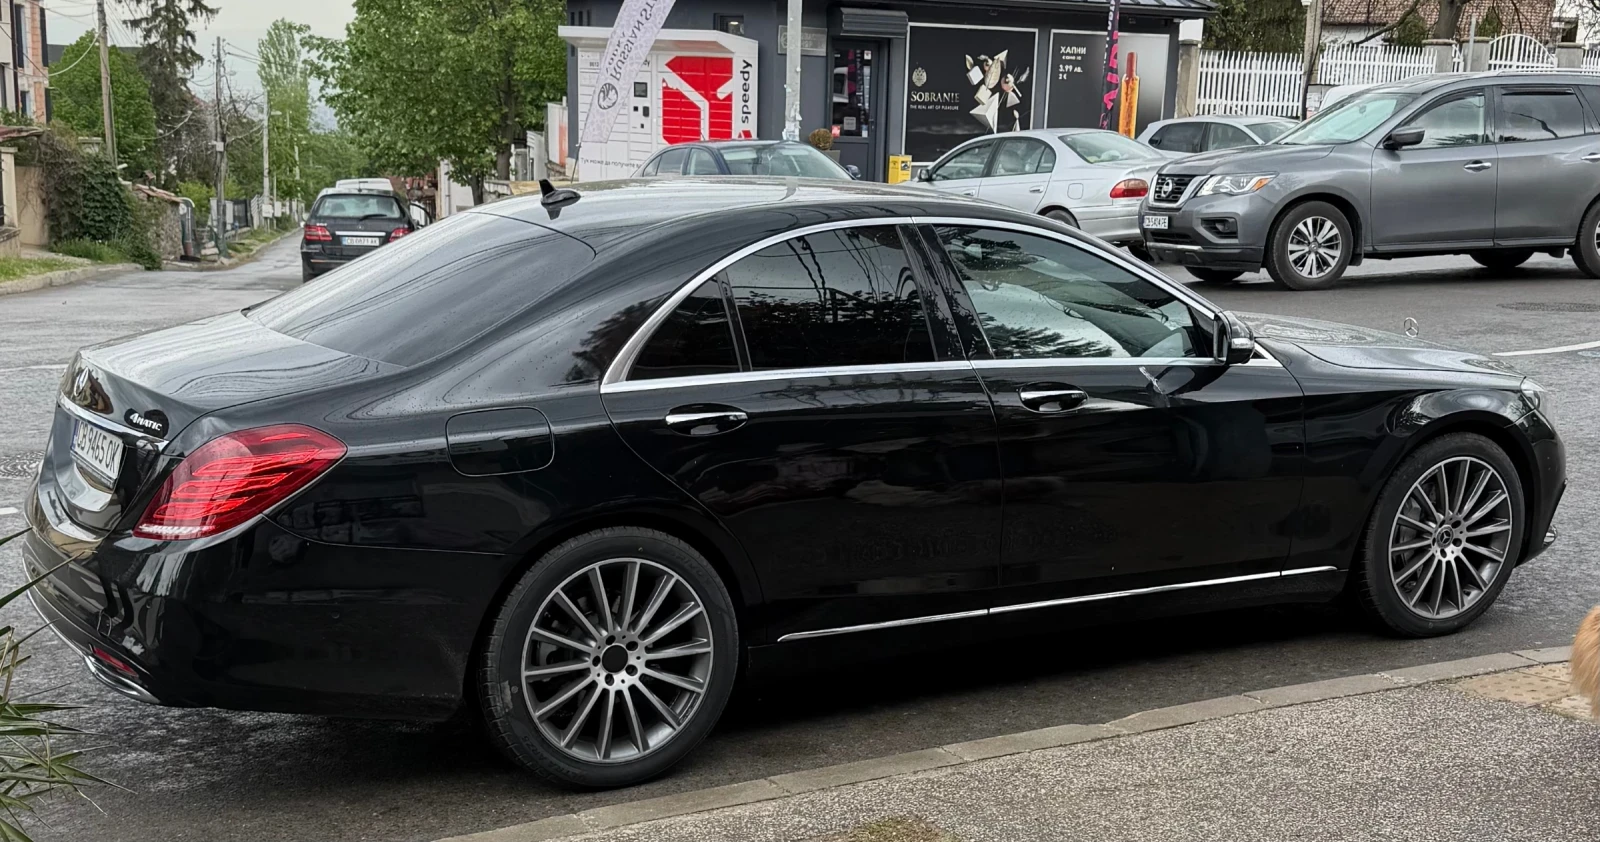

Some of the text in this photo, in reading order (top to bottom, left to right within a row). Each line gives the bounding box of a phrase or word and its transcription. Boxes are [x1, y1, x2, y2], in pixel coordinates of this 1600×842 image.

[1060, 46, 1086, 54] ХАПНИ
[740, 59, 753, 124] speedy
[911, 90, 960, 102] SOBRANIE
[87, 428, 107, 464] 9465
[106, 440, 120, 473] OK
